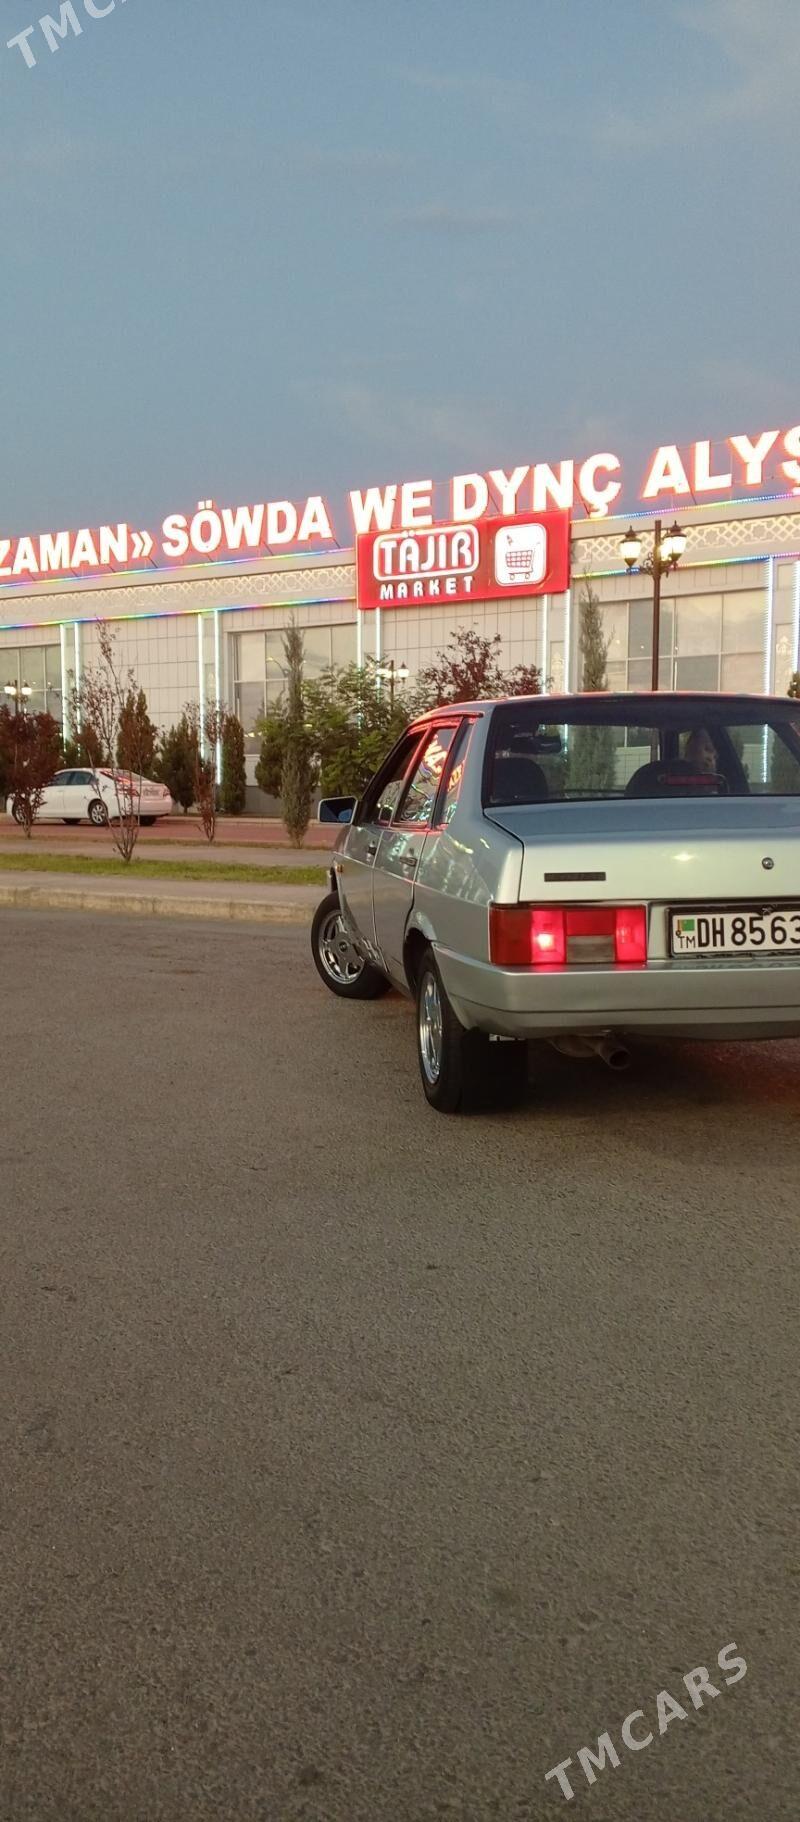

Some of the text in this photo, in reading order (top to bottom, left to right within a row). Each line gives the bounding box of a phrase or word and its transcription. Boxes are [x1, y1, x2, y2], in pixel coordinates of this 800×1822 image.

[161, 496, 332, 557] SÖWDA
[350, 480, 434, 534] WE
[452, 453, 622, 521] DYNÇ
[379, 529, 473, 575] TÄJIR
[379, 575, 474, 600] MARKET
[678, 935, 696, 949] TM
[696, 917, 725, 948] DH
